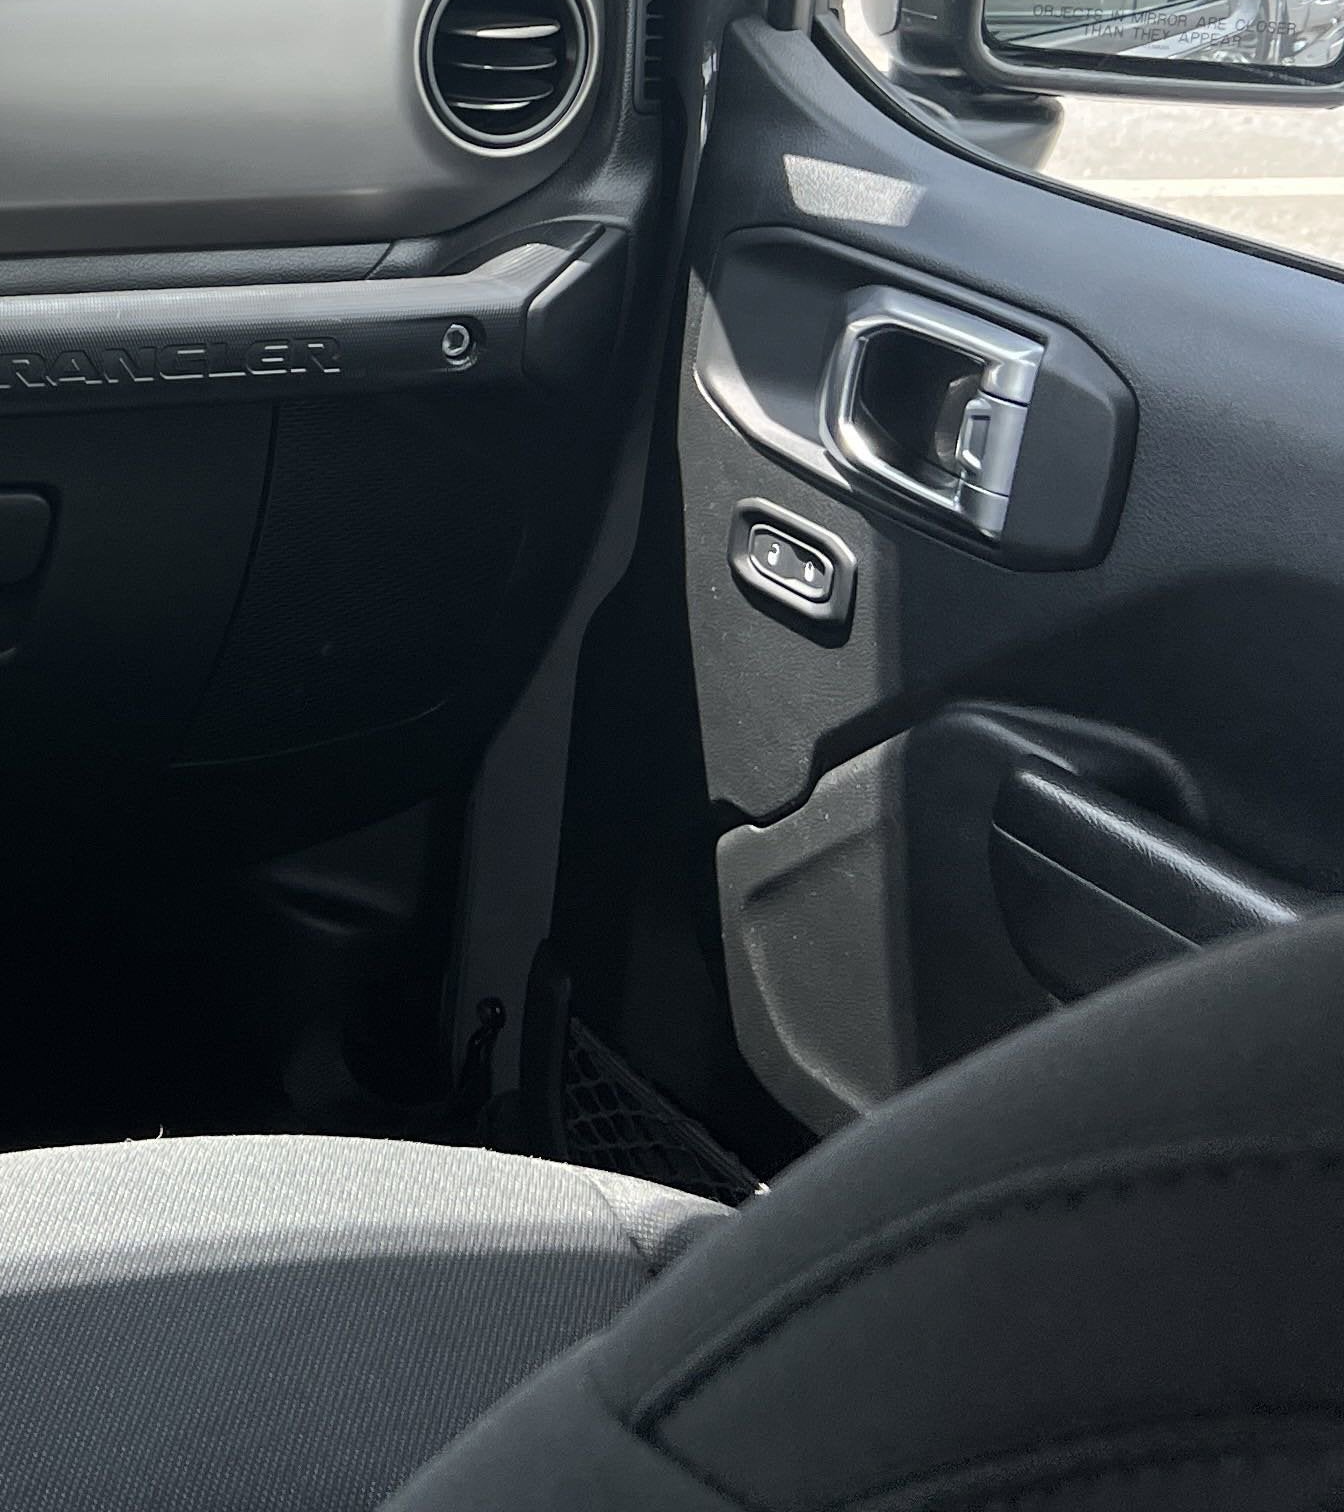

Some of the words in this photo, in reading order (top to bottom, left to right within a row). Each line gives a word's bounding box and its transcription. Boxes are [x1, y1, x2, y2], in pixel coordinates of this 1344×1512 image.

[1032, 4, 1103, 22] OBJECTS
[1111, 9, 1124, 22] IN
[1131, 12, 1188, 27] MIRROR
[1197, 16, 1229, 31] ARE
[1235, 19, 1298, 35] CLOSER
[1082, 23, 1123, 38] THAN
[1134, 27, 1169, 42] THEY
[1178, 31, 1242, 46] APPEAR
